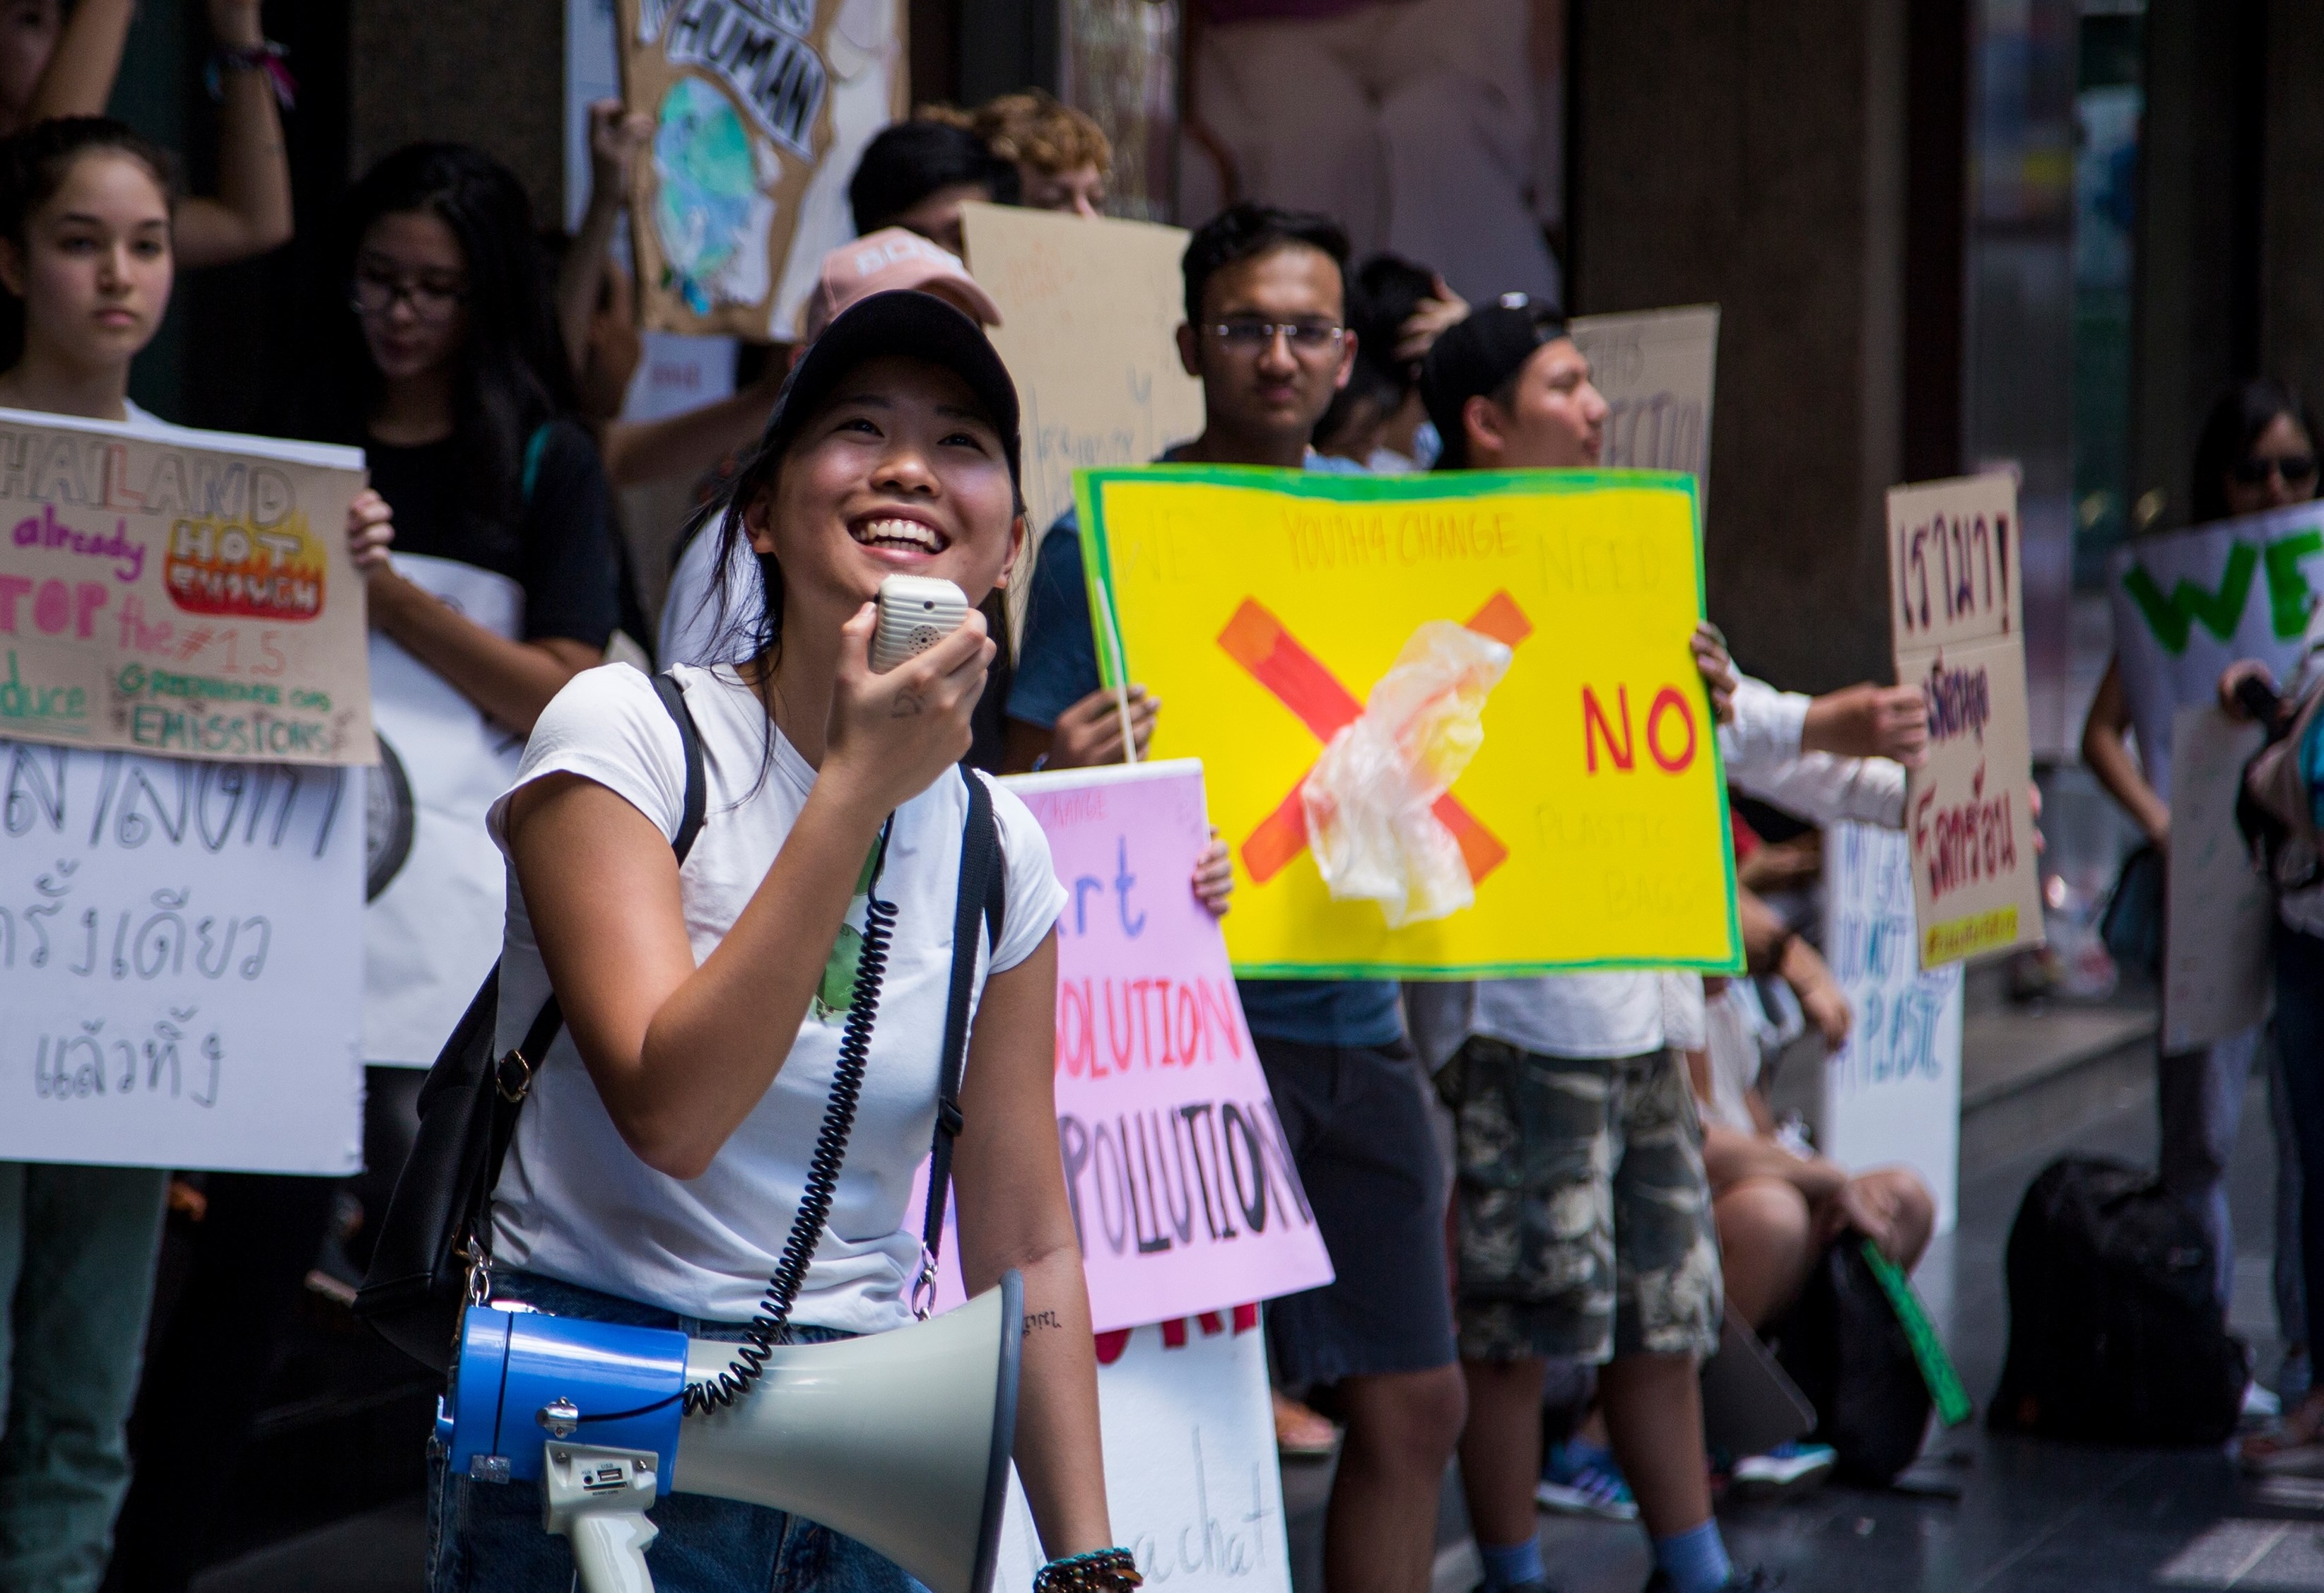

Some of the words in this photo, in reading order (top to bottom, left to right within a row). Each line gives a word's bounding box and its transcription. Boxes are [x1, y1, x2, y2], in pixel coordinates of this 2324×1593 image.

[11, 503, 146, 584] already
[173, 517, 303, 568] HOT
[117, 592, 175, 657] the
[2123, 524, 2323, 662] WE
[1582, 681, 1698, 776] NO
[1057, 834, 1146, 941] rt
[1056, 974, 1244, 1080] OLUTION
[1057, 1097, 1315, 1259] POLLUTION
